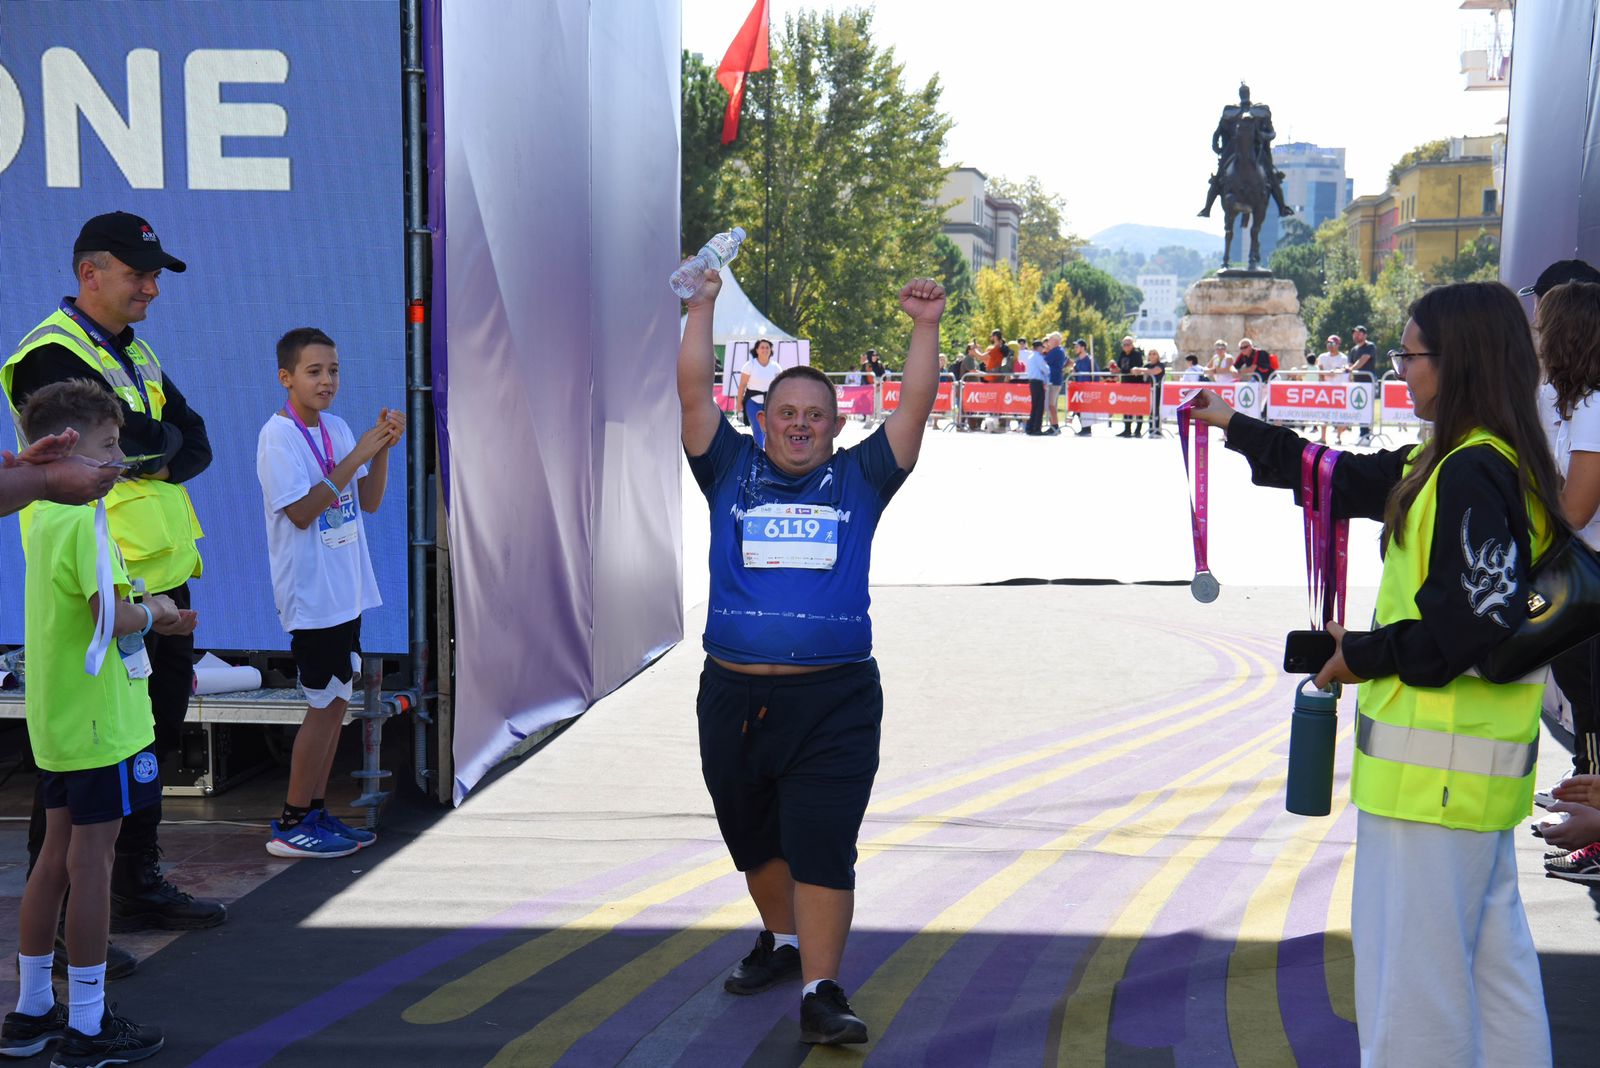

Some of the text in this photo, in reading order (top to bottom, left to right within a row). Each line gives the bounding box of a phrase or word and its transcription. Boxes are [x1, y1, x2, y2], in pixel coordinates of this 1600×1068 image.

[0, 46, 291, 191] NE
[1117, 394, 1148, 404] MoneyGram
[1287, 388, 1346, 405] SPAR
[764, 519, 820, 539] 6119
